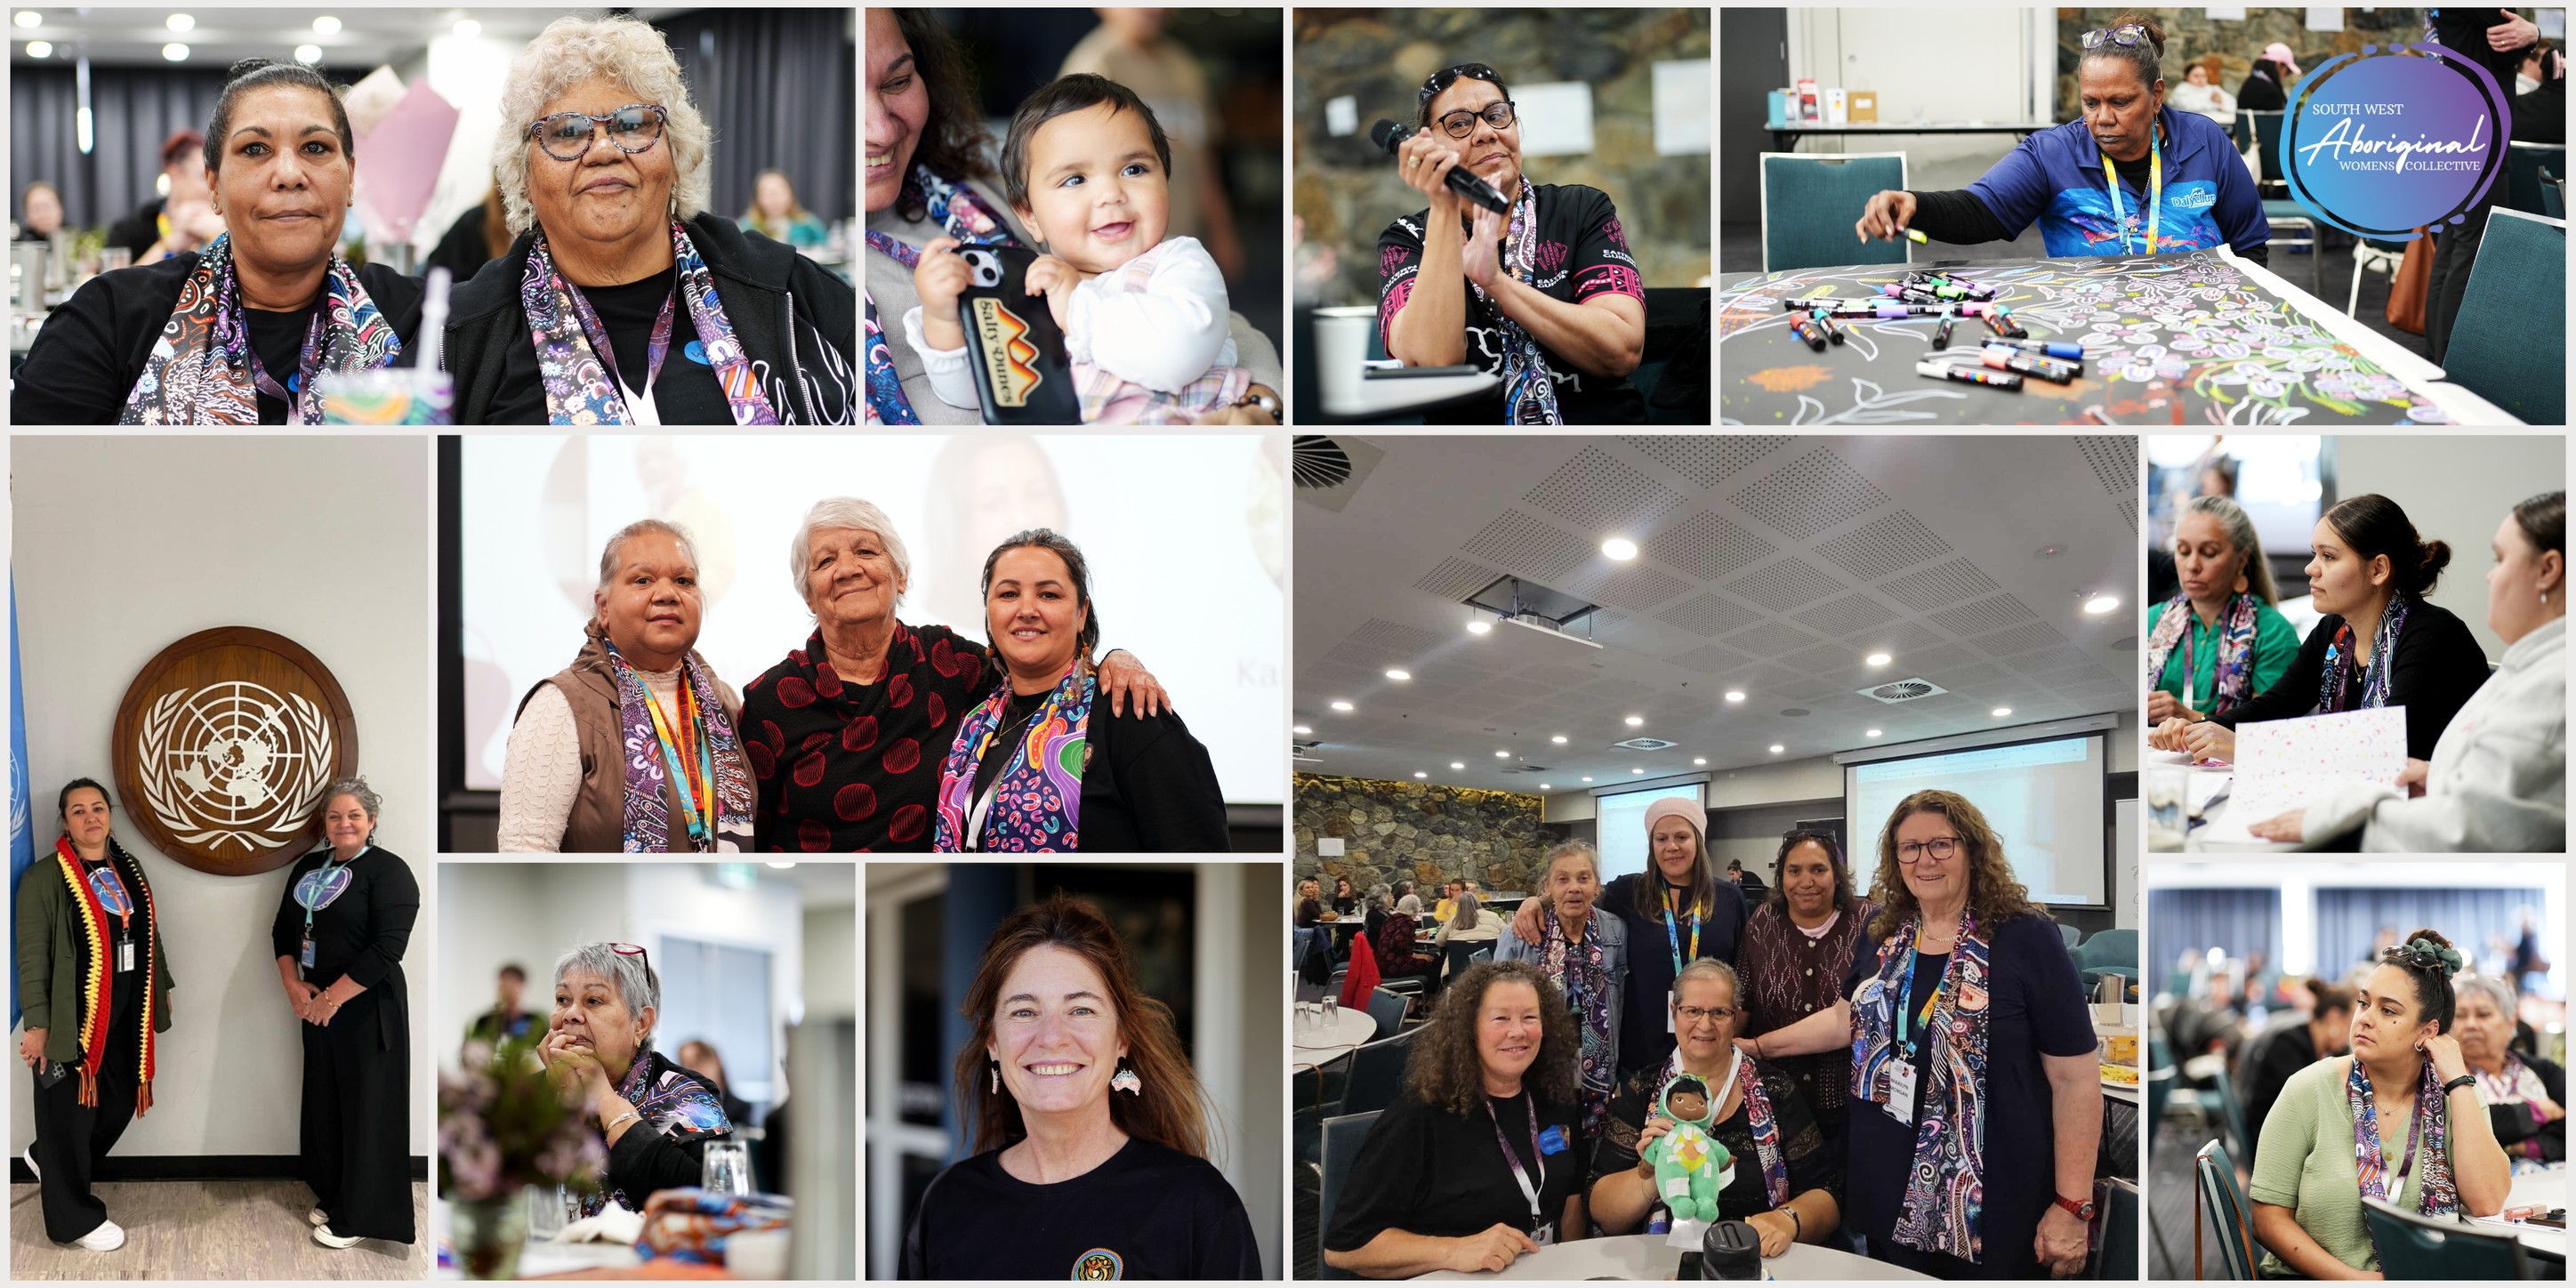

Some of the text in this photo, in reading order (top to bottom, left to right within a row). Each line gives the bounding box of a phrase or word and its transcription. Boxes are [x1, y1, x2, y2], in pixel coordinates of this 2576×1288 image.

[1536, 270, 1569, 284] EASTER
[979, 300, 1013, 403] Salty Dunes
[1237, 658, 1283, 688] Ka
[1890, 1077, 1909, 1091] MARILYN
